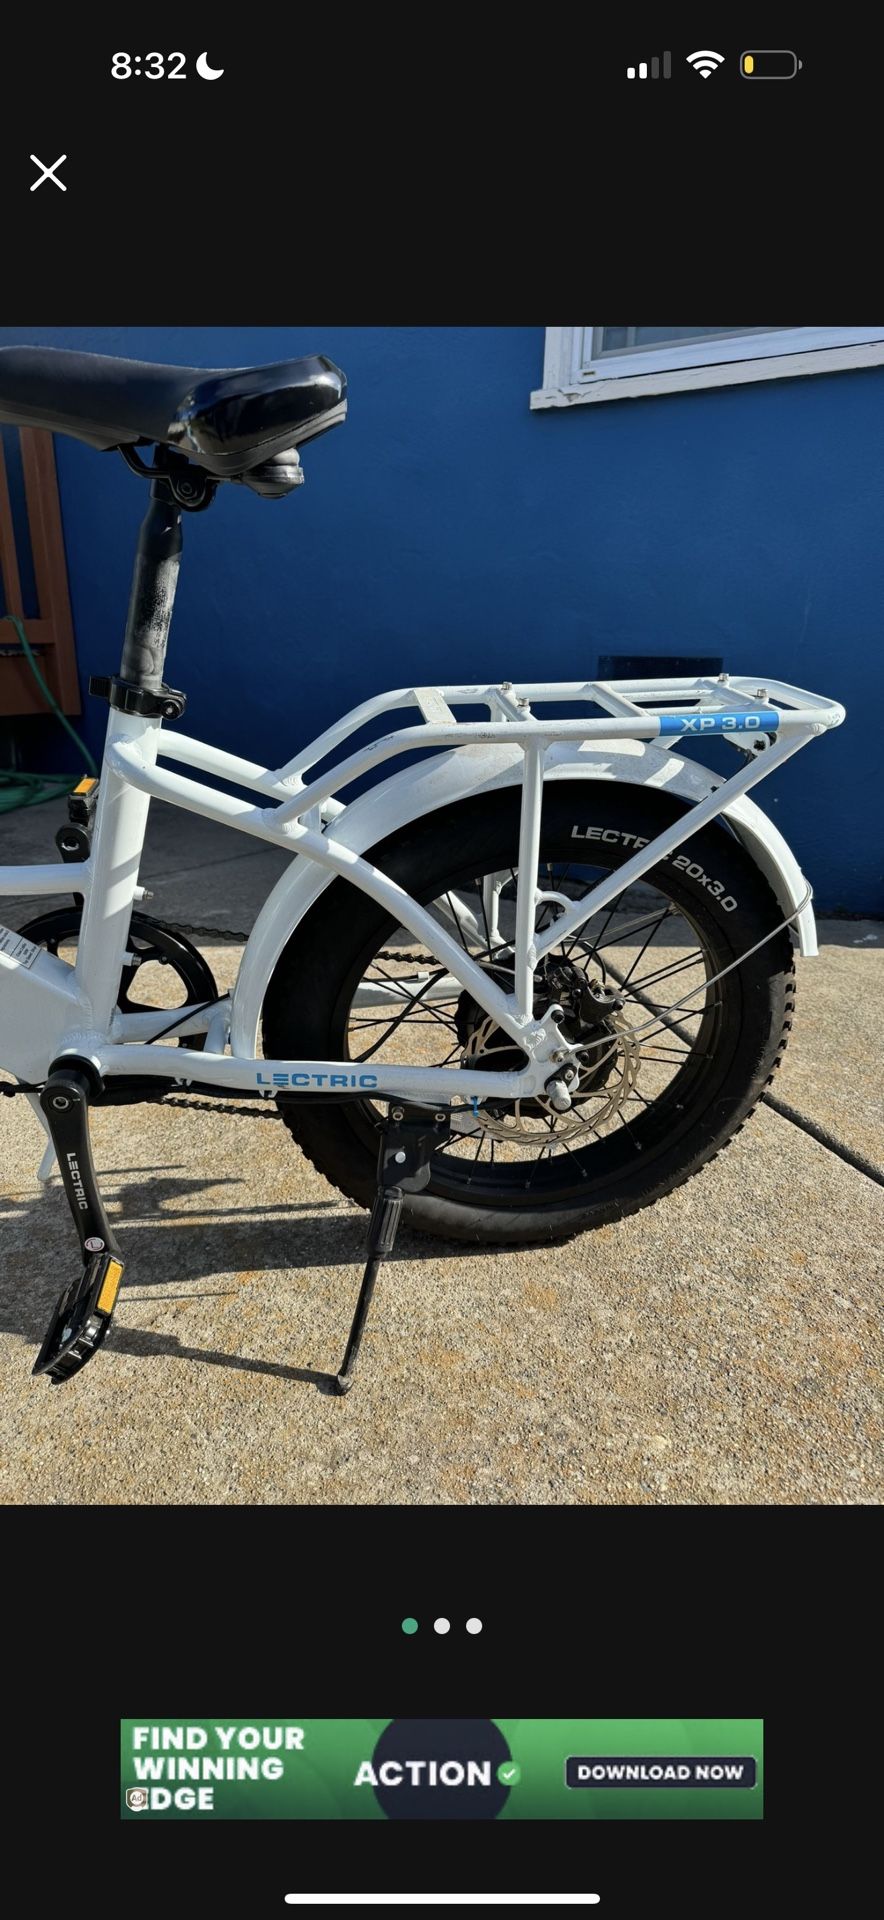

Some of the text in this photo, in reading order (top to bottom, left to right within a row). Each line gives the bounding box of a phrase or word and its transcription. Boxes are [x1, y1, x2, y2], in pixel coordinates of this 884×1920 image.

[680, 716, 761, 732] XP 3.0
[671, 855, 738, 913] 20x3.0
[256, 1072, 378, 1089] LECTRIC
[66, 1152, 89, 1211] LECTRIC
